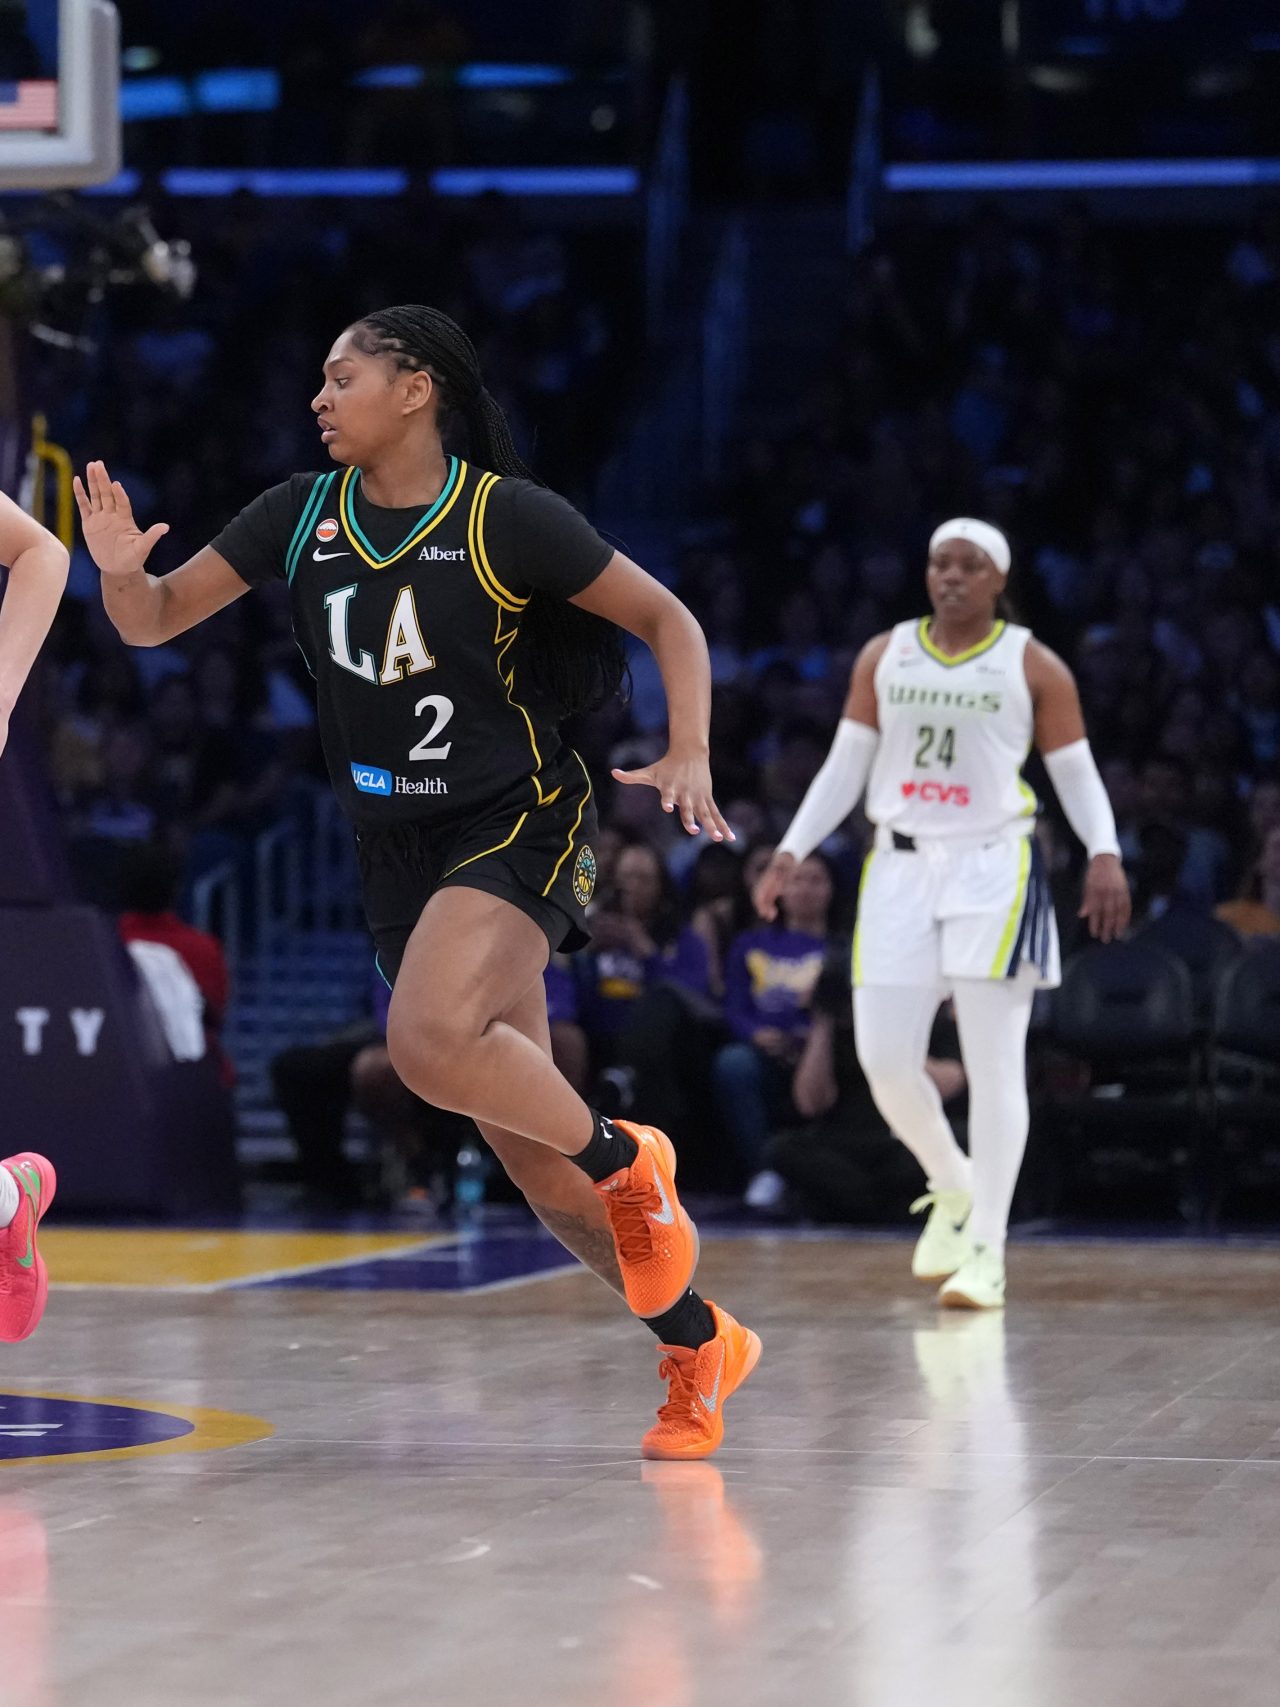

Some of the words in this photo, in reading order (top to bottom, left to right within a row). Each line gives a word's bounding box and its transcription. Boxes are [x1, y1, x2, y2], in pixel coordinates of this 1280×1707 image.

[417, 546, 466, 562] Albert
[323, 583, 437, 686] LA
[408, 694, 455, 762] 2
[914, 724, 956, 771] 24
[352, 769, 387, 791] UCLA
[394, 776, 449, 796] Health
[919, 781, 970, 806] CVS
